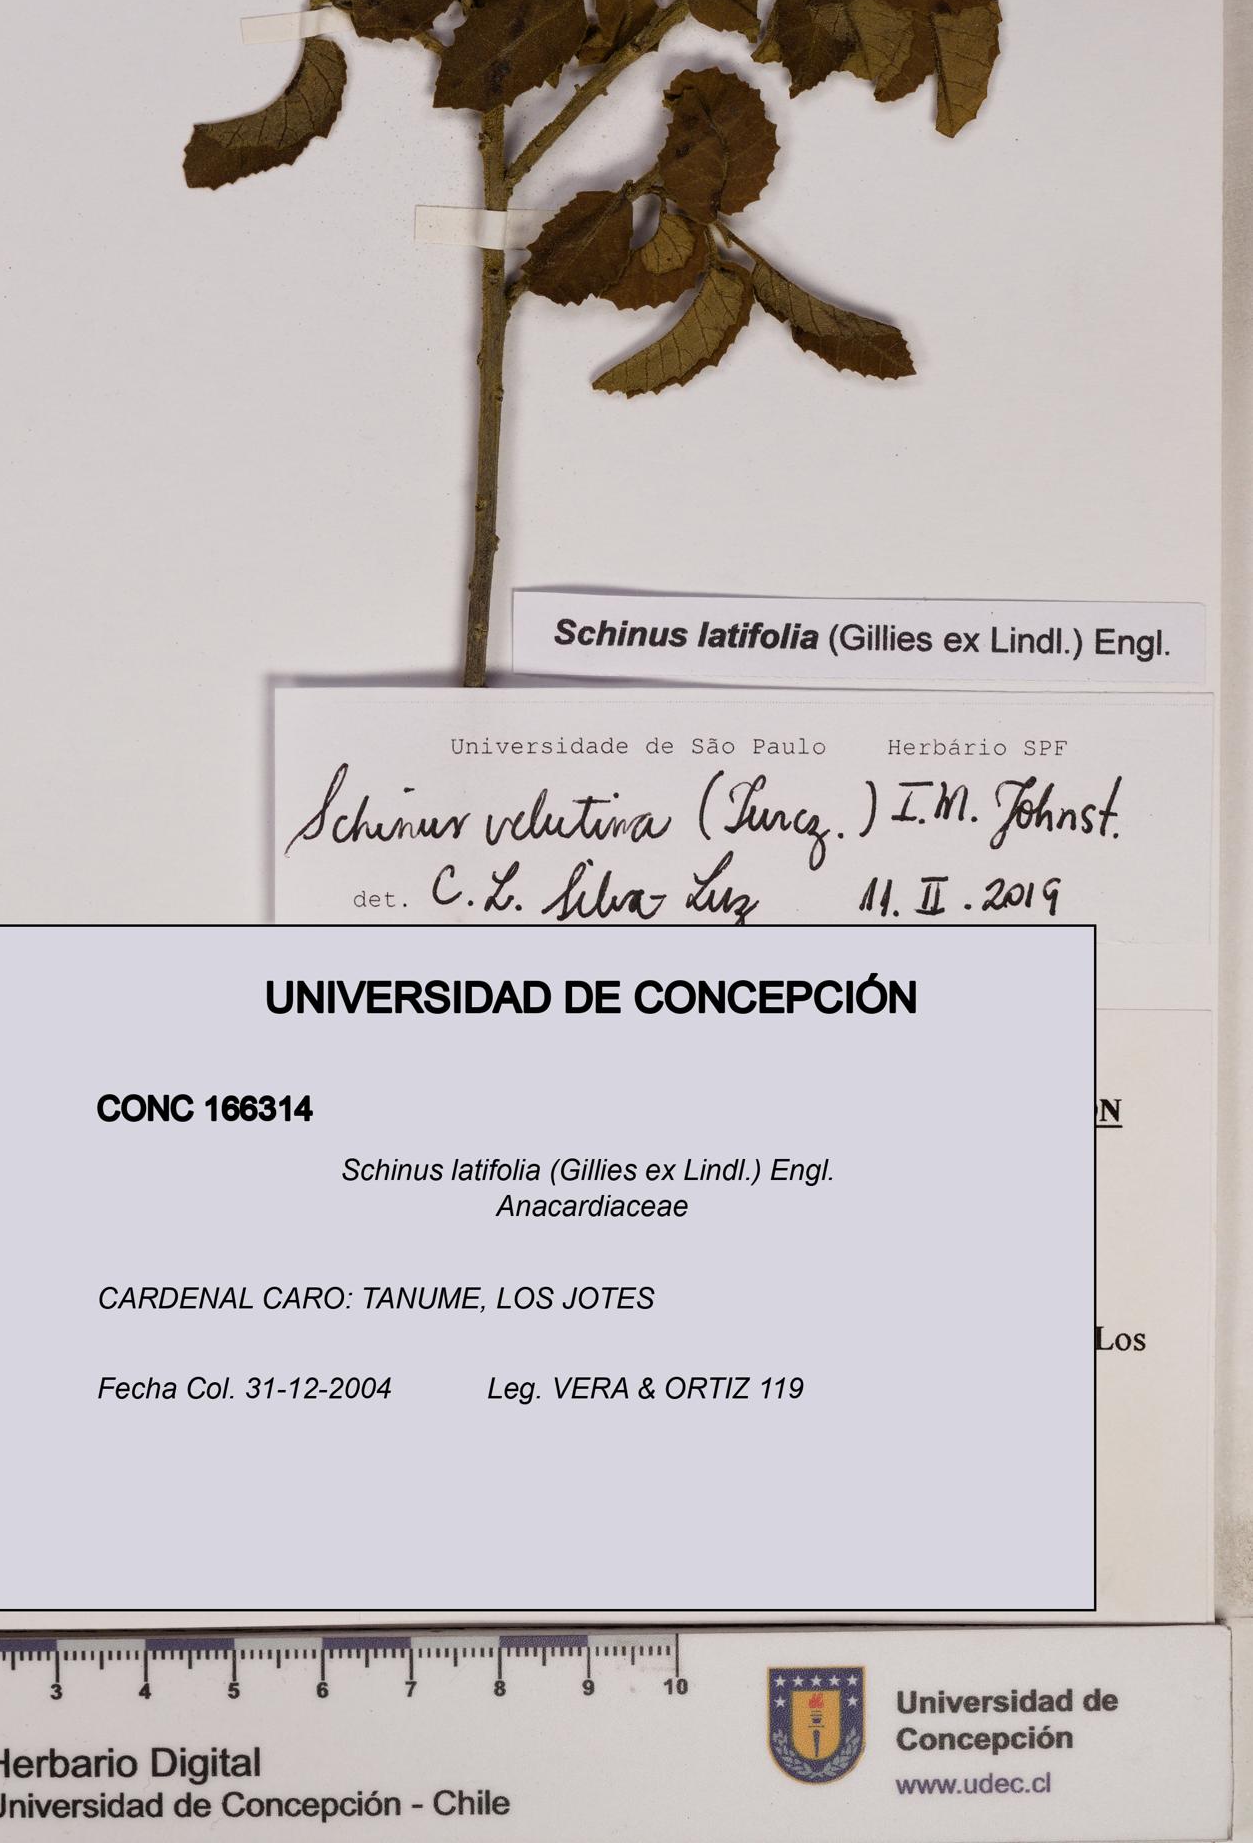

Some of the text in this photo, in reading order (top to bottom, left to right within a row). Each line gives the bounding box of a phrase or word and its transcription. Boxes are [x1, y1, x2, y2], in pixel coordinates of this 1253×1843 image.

[554, 618, 1170, 663] Schinus latifolia (Gillies ex Lindl.) Engl.
[451, 736, 1068, 756] Universidade de São Paulo Herbário SPF
[353, 890, 407, 908] det.
[431, 864, 474, 907] C.
[1095, 1325, 1147, 1352] Los
[50, 1683, 63, 1701] 3
[138, 1682, 152, 1700] 4
[227, 1681, 241, 1700] 5
[316, 1681, 329, 1699] 6
[404, 1679, 418, 1698] 7
[493, 1679, 507, 1697] 8
[581, 1679, 596, 1697] 9
[663, 1675, 689, 1696] 10
[897, 1687, 1119, 1715] Universidad de
[895, 1725, 1074, 1756] Concepción
[151, 1746, 261, 1786] Digital
[895, 1771, 1051, 1795] www.udec.cl
[173, 1791, 212, 1819] de
[220, 1790, 402, 1824] Concepción
[433, 1789, 511, 1817] Chile
